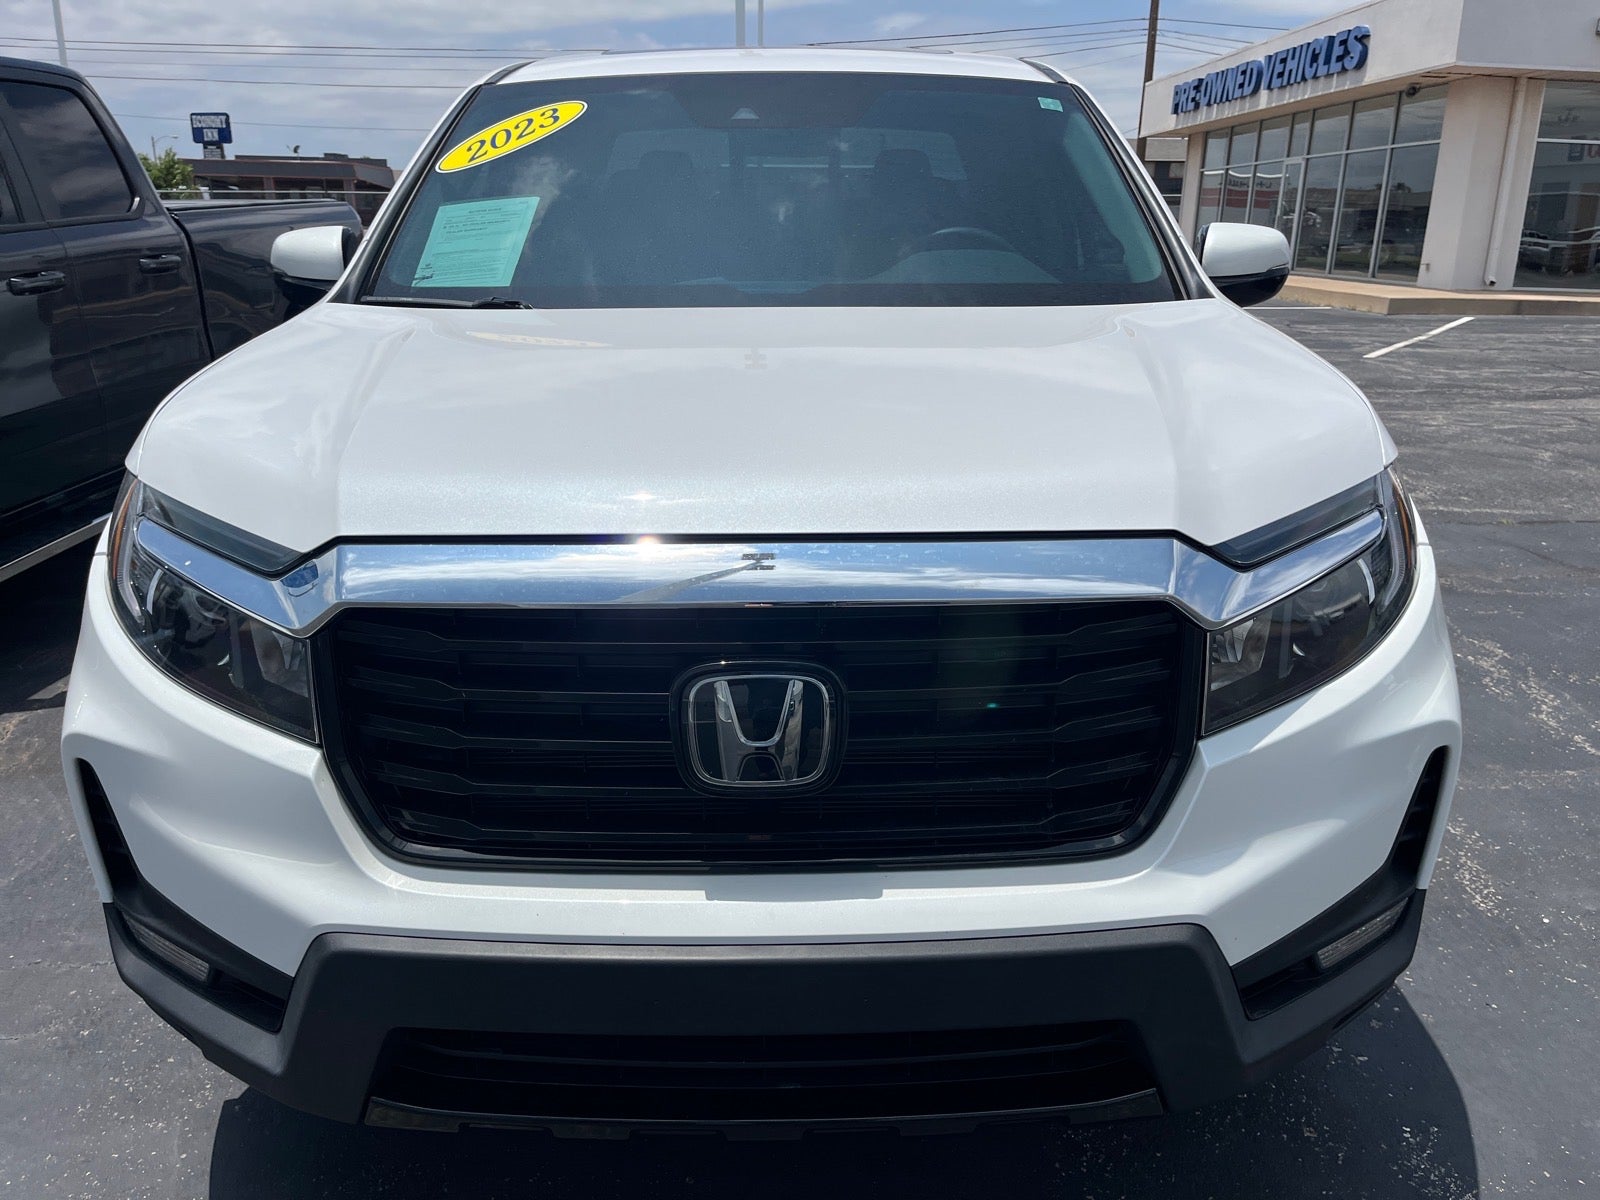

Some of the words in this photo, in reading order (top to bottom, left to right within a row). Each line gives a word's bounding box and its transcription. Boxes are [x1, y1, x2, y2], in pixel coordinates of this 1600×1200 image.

[1171, 59, 1264, 114] PRE-OWNED
[1263, 25, 1371, 90] VEHICLES
[466, 107, 560, 163] 2023
